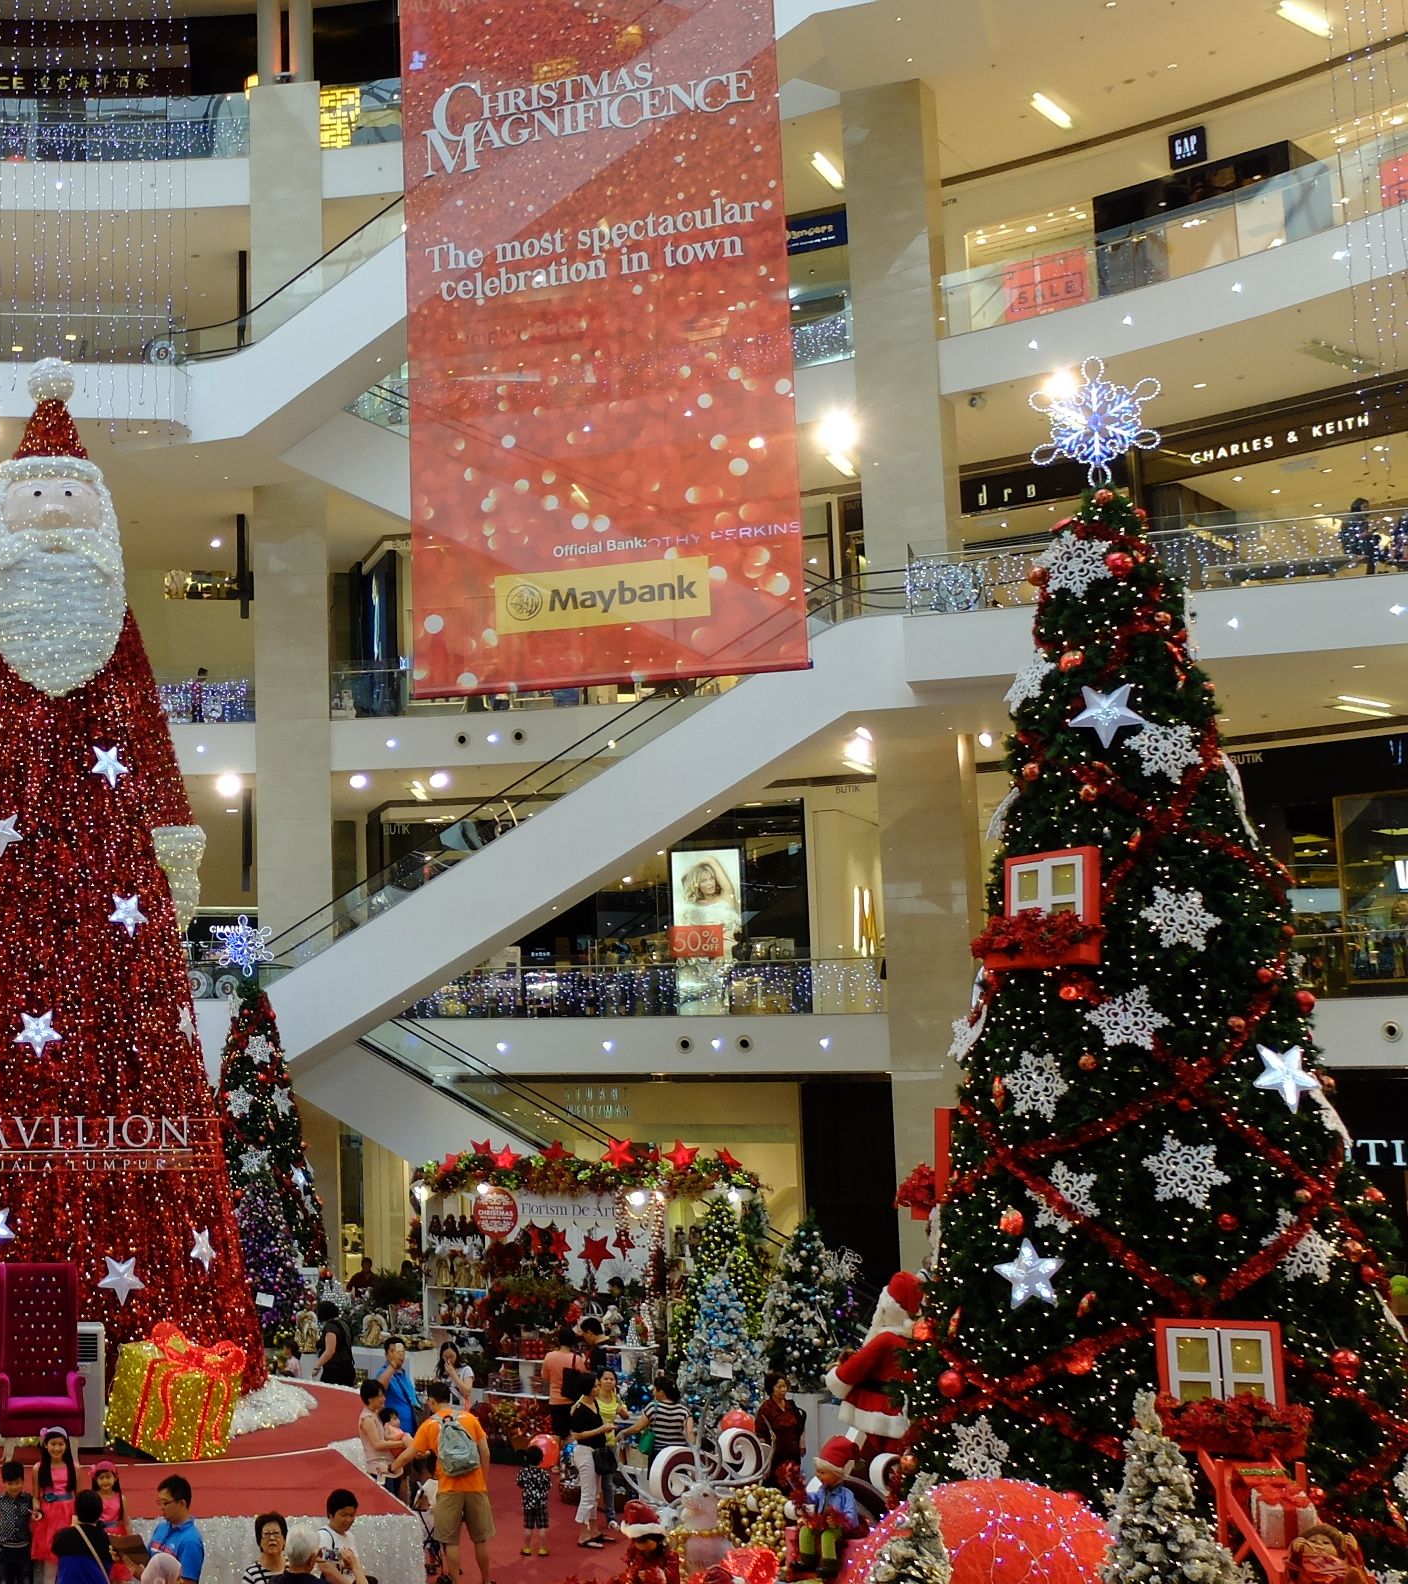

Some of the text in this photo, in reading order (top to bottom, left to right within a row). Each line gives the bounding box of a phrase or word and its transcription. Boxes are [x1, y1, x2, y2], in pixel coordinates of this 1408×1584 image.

[432, 62, 654, 142] CHRISTMAS
[422, 69, 755, 178] MAGNIFICENCE
[1175, 135, 1197, 156] GAP
[425, 243, 484, 273] The
[495, 228, 565, 264] most
[577, 198, 760, 257] spectacular
[441, 235, 744, 302] celebration in town
[1191, 414, 1370, 464] CHARLES & KEITH
[553, 537, 647, 558] Official Bank:
[549, 574, 697, 613] Maybank
[701, 943, 720, 952] OFF
[225, 983, 231, 994] 3
[71, 1158, 167, 1172] LUMPUR
